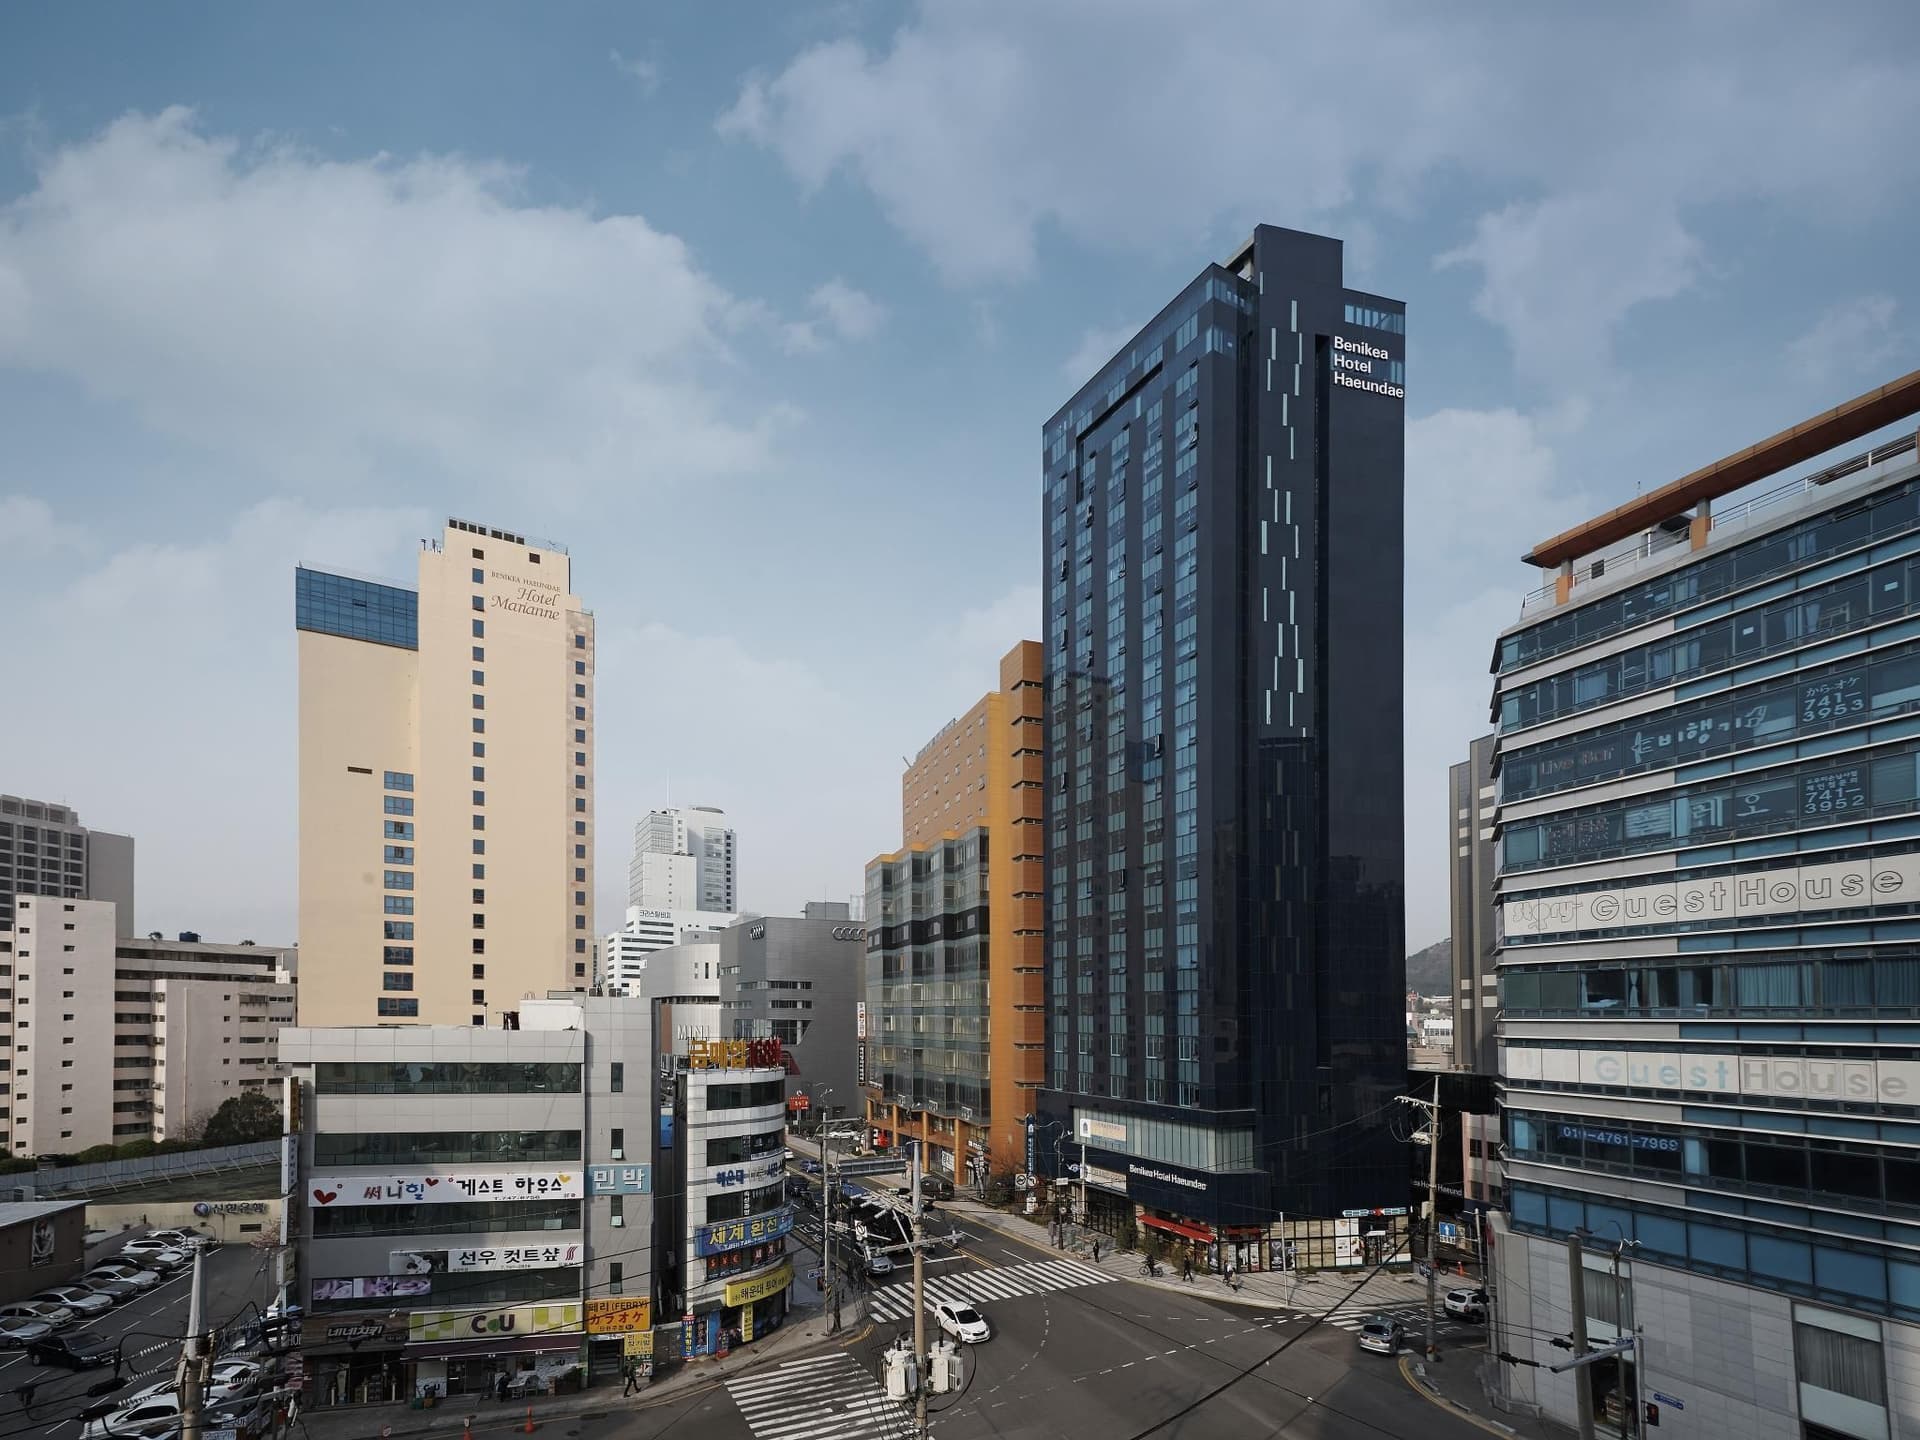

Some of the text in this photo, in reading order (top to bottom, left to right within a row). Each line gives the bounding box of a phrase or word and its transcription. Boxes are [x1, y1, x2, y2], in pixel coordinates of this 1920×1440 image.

[1334, 335, 1389, 360] Benikea
[1334, 353, 1372, 374] Hotel
[1334, 371, 1404, 398] Haeundae
[491, 571, 521, 583] BENIKEA
[517, 587, 560, 606] Hotel
[490, 595, 560, 620] Marianne
[1802, 699, 1865, 722] 3953
[1804, 794, 1865, 814] 3952
[1591, 881, 1726, 922] Guest
[1739, 870, 1903, 907] House
[677, 1025, 710, 1040] MINI
[688, 1038, 747, 1069] 금매입
[1595, 1055, 1907, 1098] Guest House
[456, 1178, 504, 1196] 게스트
[515, 1177, 563, 1194] 하우스
[593, 1167, 646, 1191] 민박
[716, 1169, 745, 1188] 해운대
[1129, 1164, 1154, 1178] Benikea
[1154, 1169, 1171, 1182] Hotel
[1171, 1173, 1208, 1190] Haeundae
[212, 1202, 265, 1215] 신한은행
[709, 1222, 745, 1245] 세계
[751, 1215, 777, 1237] 환전
[458, 1250, 496, 1266] 선우
[740, 1283, 764, 1300] 해운대
[471, 1314, 516, 1334] CU
[589, 1311, 644, 1325] カラオケ
